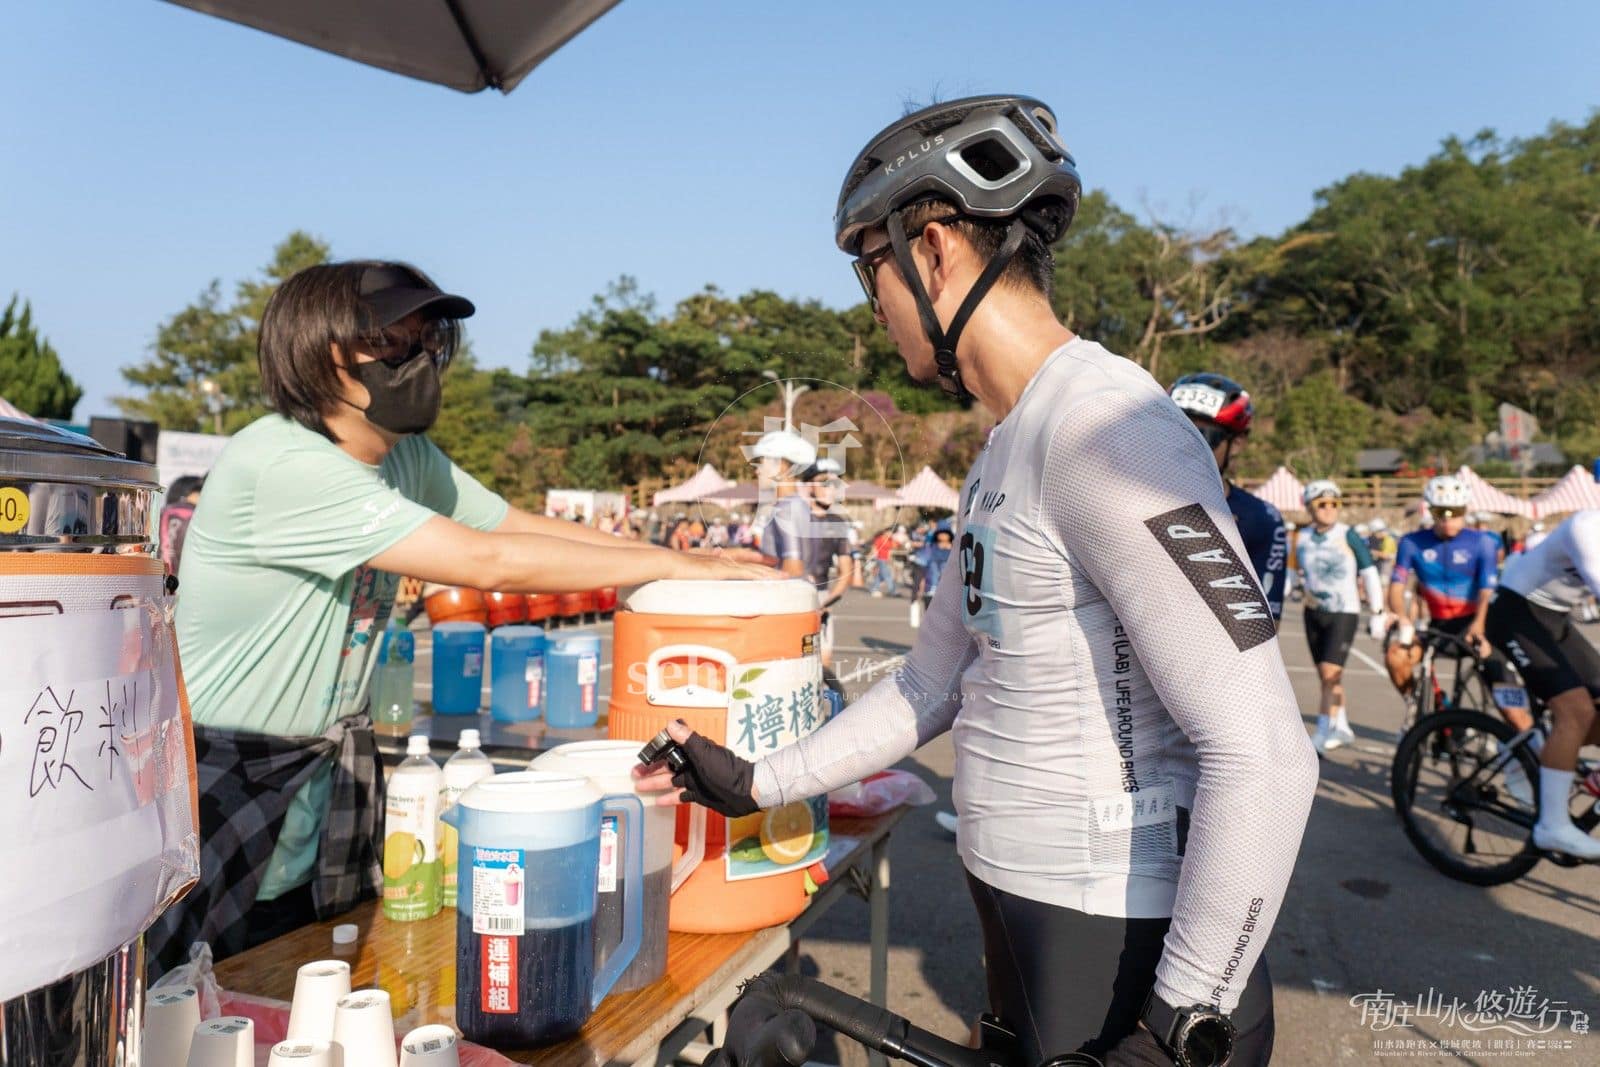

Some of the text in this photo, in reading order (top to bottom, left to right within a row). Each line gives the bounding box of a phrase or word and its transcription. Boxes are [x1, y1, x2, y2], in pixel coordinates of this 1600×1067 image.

[884, 134, 945, 176] KPLUS
[1166, 523, 1269, 622] MAAP
[1115, 678, 1131, 705] LIFE
[24, 679, 142, 798] 飲料
[1116, 706, 1134, 758] AROUND
[1119, 760, 1140, 794] BIKES
[1221, 934, 1250, 985] AROUND
[1242, 897, 1264, 934] BIKES
